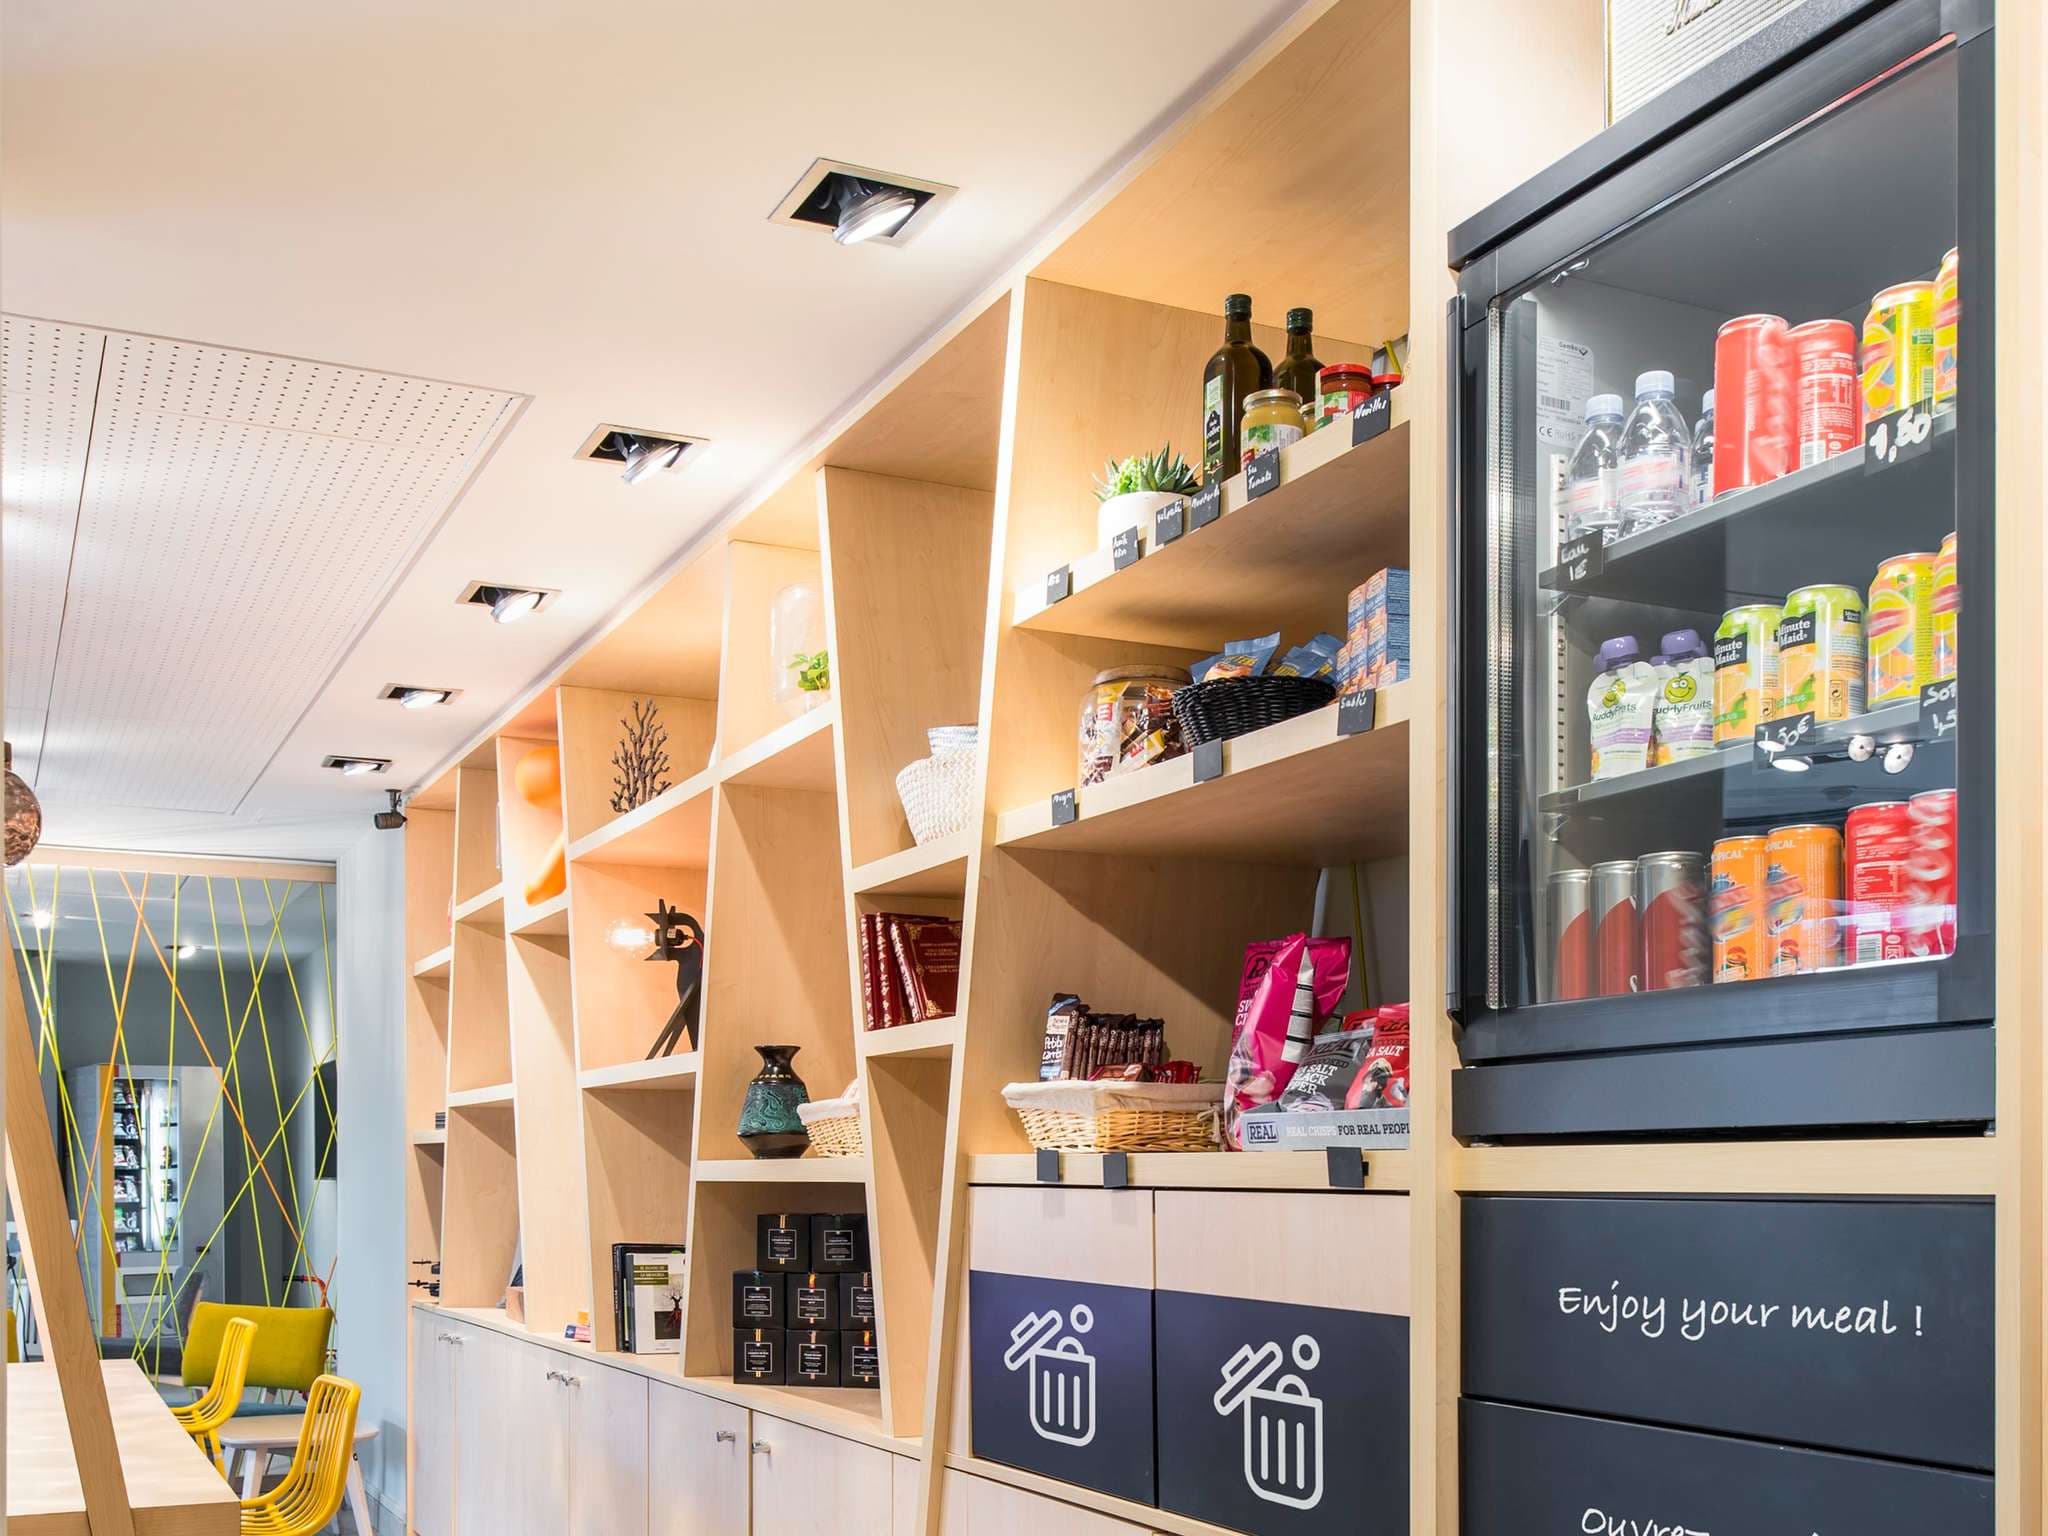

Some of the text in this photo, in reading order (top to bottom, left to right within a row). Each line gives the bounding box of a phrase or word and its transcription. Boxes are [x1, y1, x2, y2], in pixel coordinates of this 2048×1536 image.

[1375, 1045, 1404, 1057] SALT
[1307, 1063, 1338, 1077] SALT
[1250, 1125, 1277, 1141] REAL
[1338, 1125, 1356, 1136] FOR
[1357, 1123, 1381, 1136] REAL
[1558, 1280, 1923, 1341] Enjoy your meal !
[1581, 1508, 1710, 1536] Ouvr
